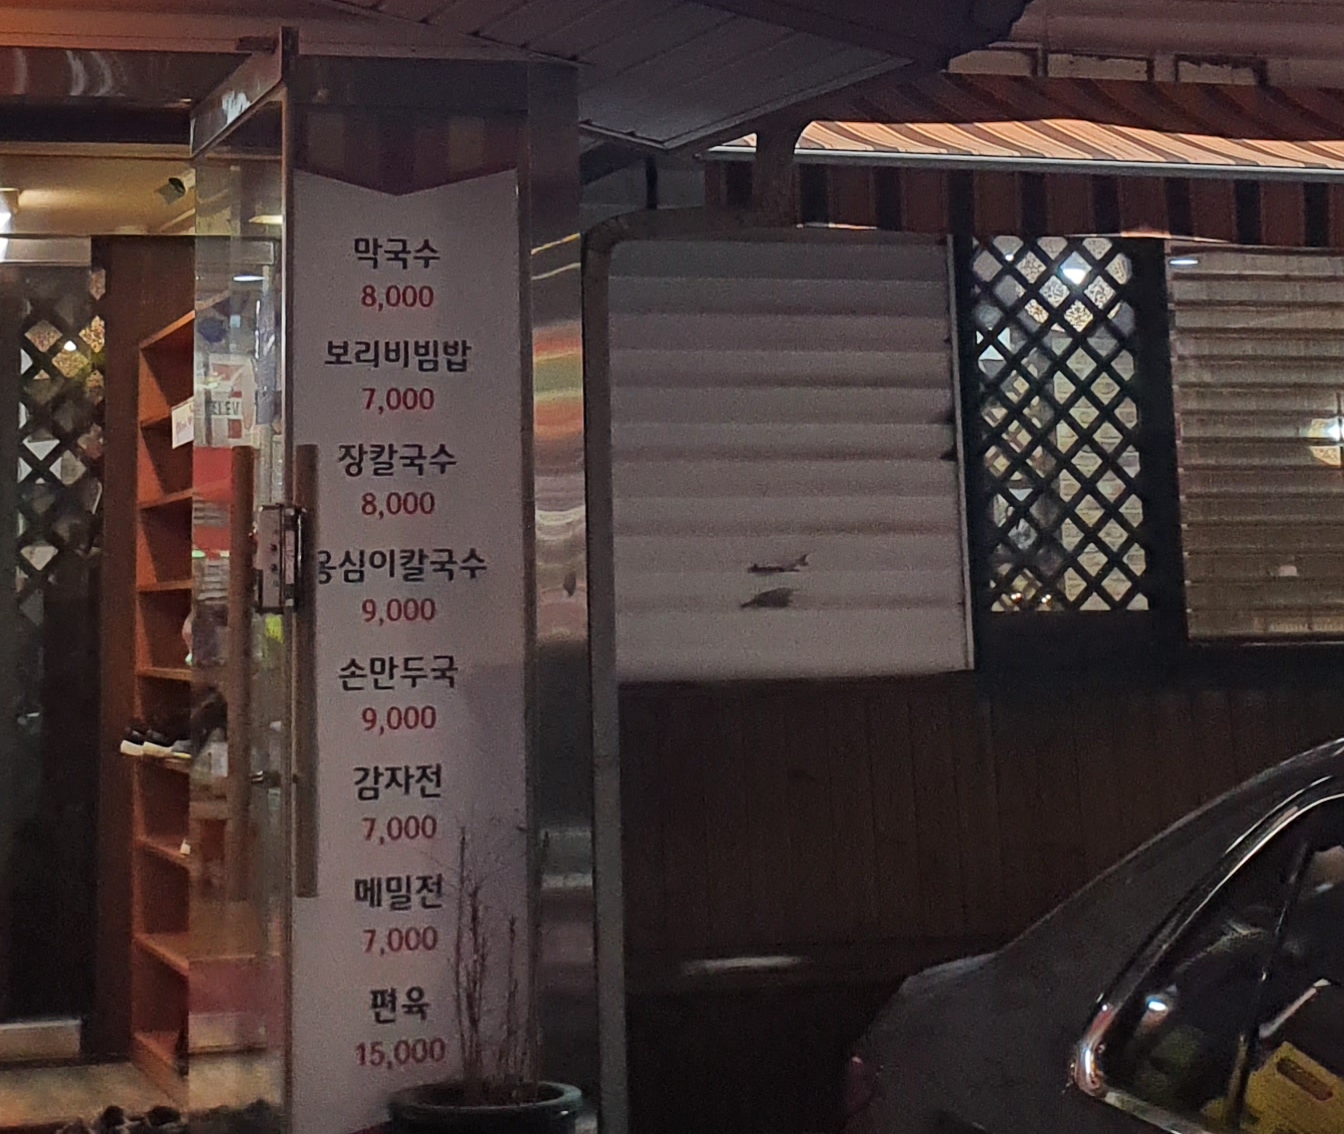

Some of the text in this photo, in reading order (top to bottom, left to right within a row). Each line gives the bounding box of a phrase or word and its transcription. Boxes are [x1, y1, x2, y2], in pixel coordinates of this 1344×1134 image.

[354, 237, 442, 270] 막국수
[361, 284, 435, 312] 8,000
[324, 339, 472, 373] 보리비빔밥
[361, 387, 435, 415] 7,000
[338, 443, 457, 478] 장칼국수
[361, 491, 436, 520] 8,000
[361, 598, 437, 626] 9,000
[338, 655, 458, 691] 손만두국
[361, 705, 437, 737] 9,000
[353, 763, 443, 801] 감자전
[362, 815, 437, 846] 7,000
[355, 873, 444, 911] 메밀전
[363, 926, 438, 956] 7,000
[369, 986, 431, 1024] 편육
[356, 1037, 447, 1069] 15,000
